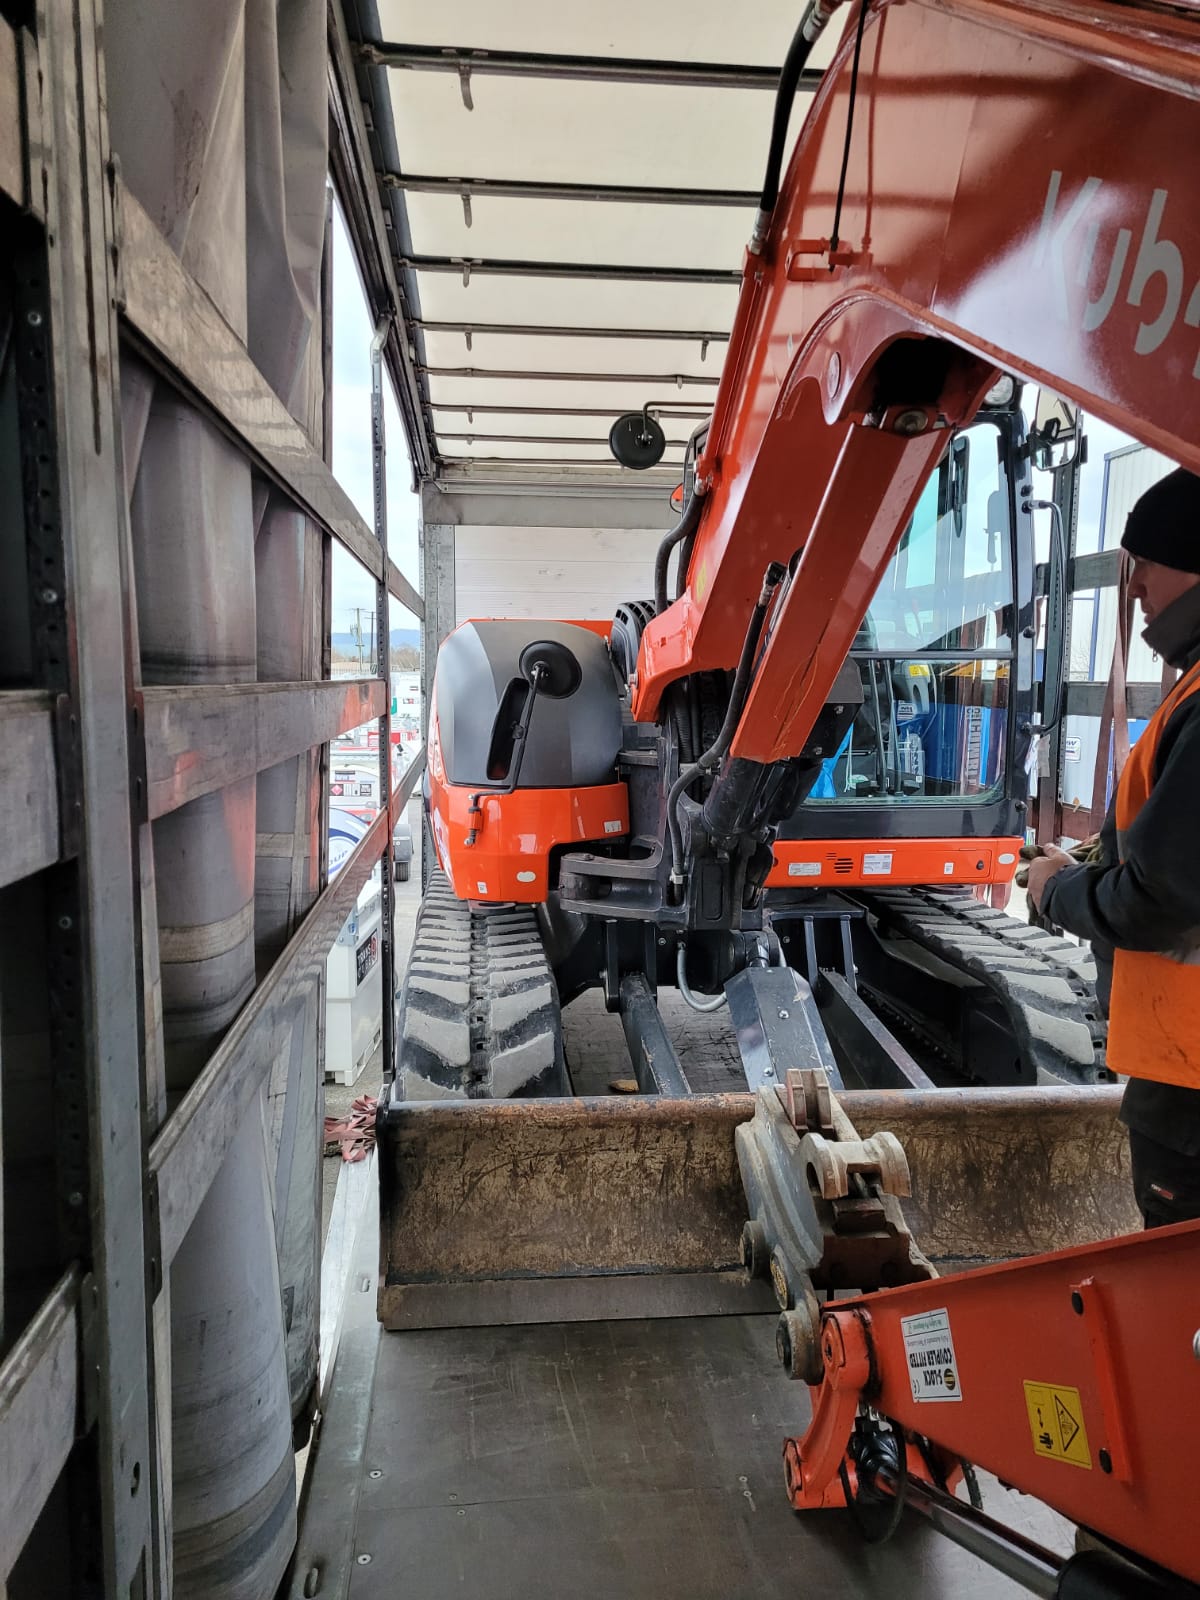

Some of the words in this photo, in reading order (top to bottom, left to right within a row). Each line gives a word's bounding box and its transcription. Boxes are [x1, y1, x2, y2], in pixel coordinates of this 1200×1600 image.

[1033, 170, 1200, 382] Kub
[909, 1351, 927, 1368] FITTED
[927, 1347, 953, 1366] COUPLER
